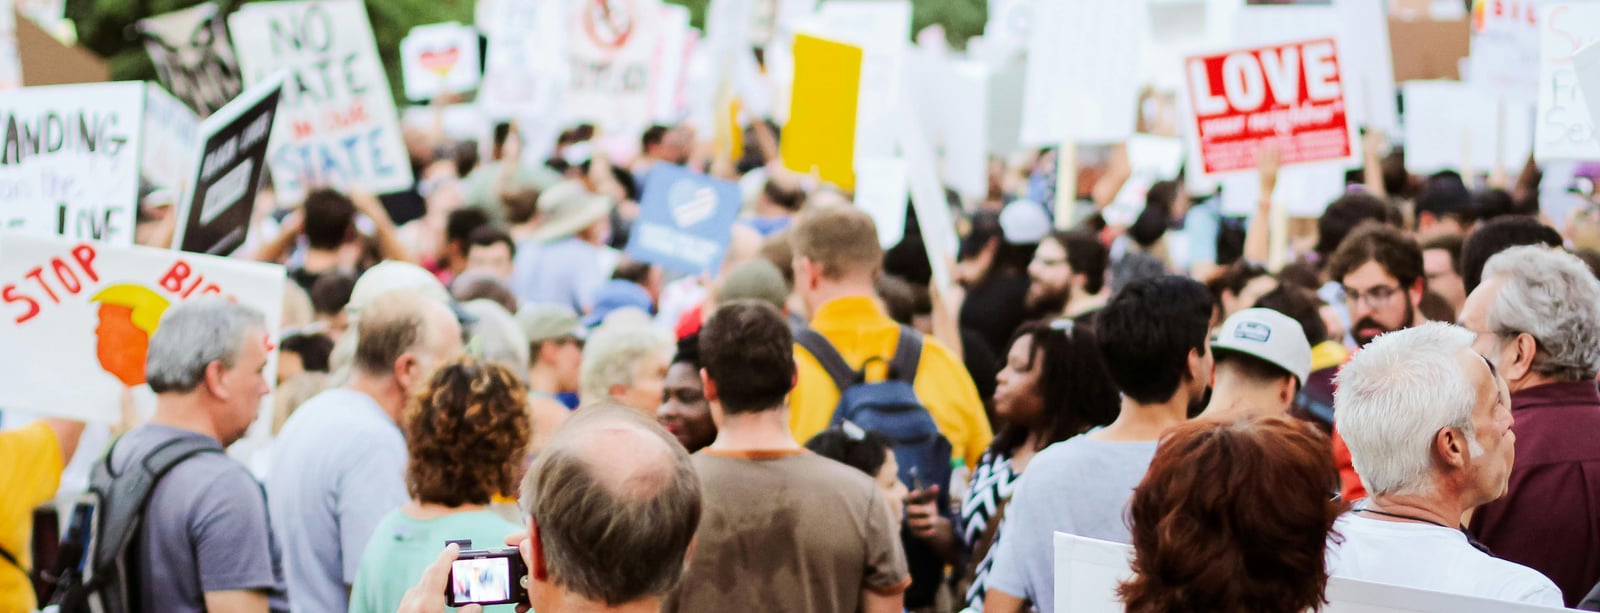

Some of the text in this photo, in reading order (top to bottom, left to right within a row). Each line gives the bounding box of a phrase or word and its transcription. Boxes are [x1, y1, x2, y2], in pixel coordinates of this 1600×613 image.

[268, 6, 333, 57] NO
[1189, 42, 1342, 116] LOVE
[0, 113, 128, 165] ANDING
[272, 127, 396, 188] STATE
[1, 244, 99, 324] STOP
